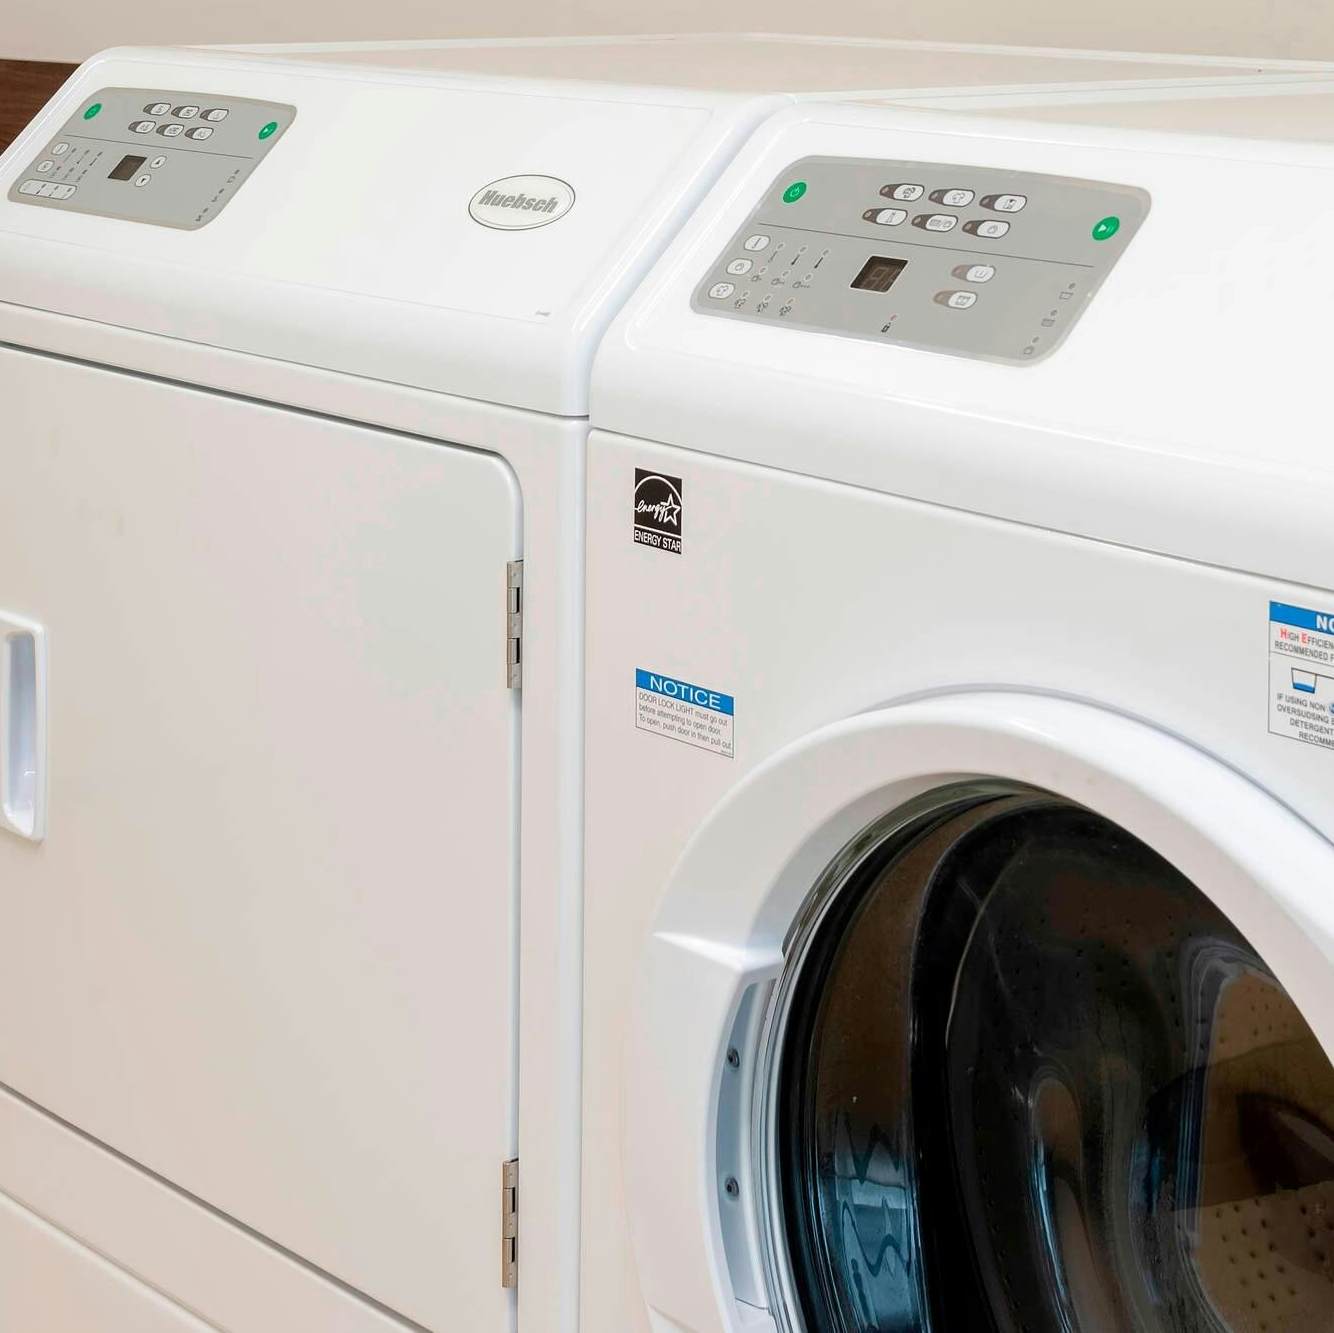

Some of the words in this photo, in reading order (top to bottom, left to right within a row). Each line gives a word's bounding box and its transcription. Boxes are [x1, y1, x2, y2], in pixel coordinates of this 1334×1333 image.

[478, 189, 559, 214] Huebsch
[634, 529, 662, 547] ENERGY
[663, 537, 681, 552] STAR
[1274, 640, 1328, 661] RECOMMENDED
[650, 675, 721, 710] NOTICE
[1285, 696, 1308, 707] USING
[1309, 701, 1326, 712] NON
[1290, 717, 1334, 736] DETERGENT
